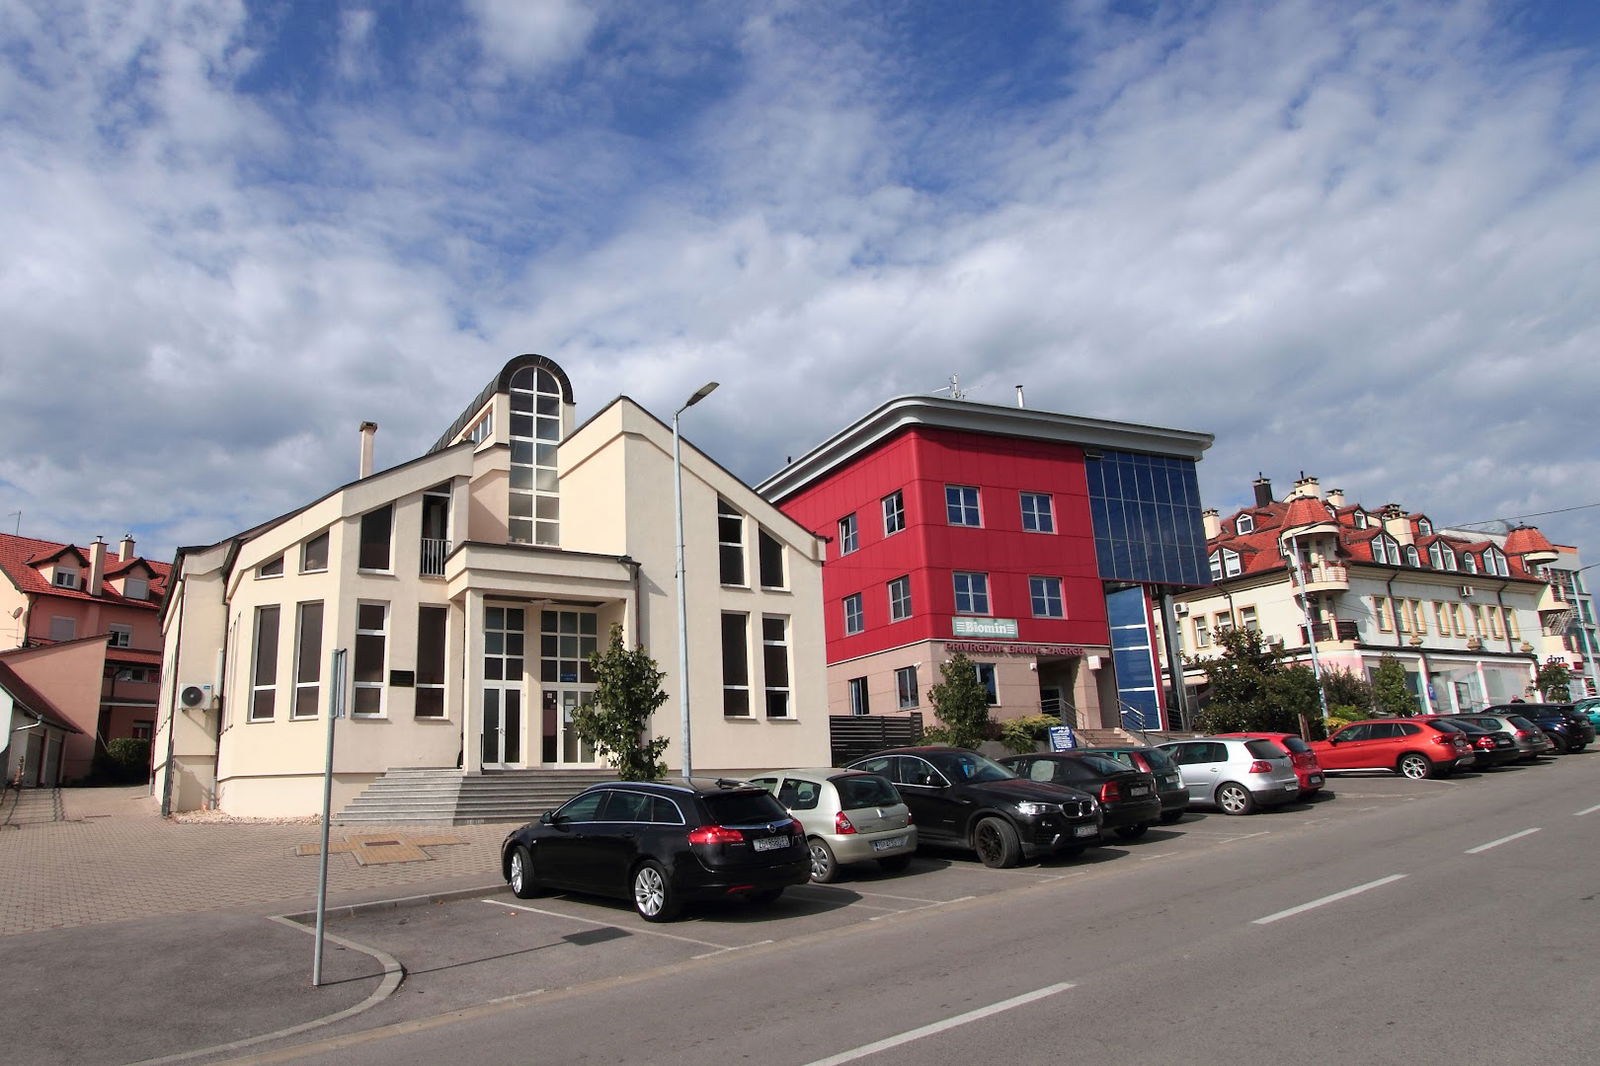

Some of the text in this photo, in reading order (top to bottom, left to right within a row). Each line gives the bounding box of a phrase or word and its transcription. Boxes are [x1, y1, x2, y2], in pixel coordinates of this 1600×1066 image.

[965, 622, 1007, 634] Biomin
[1045, 647, 1085, 656] ZAGREB
[1547, 655, 1565, 664] dm
